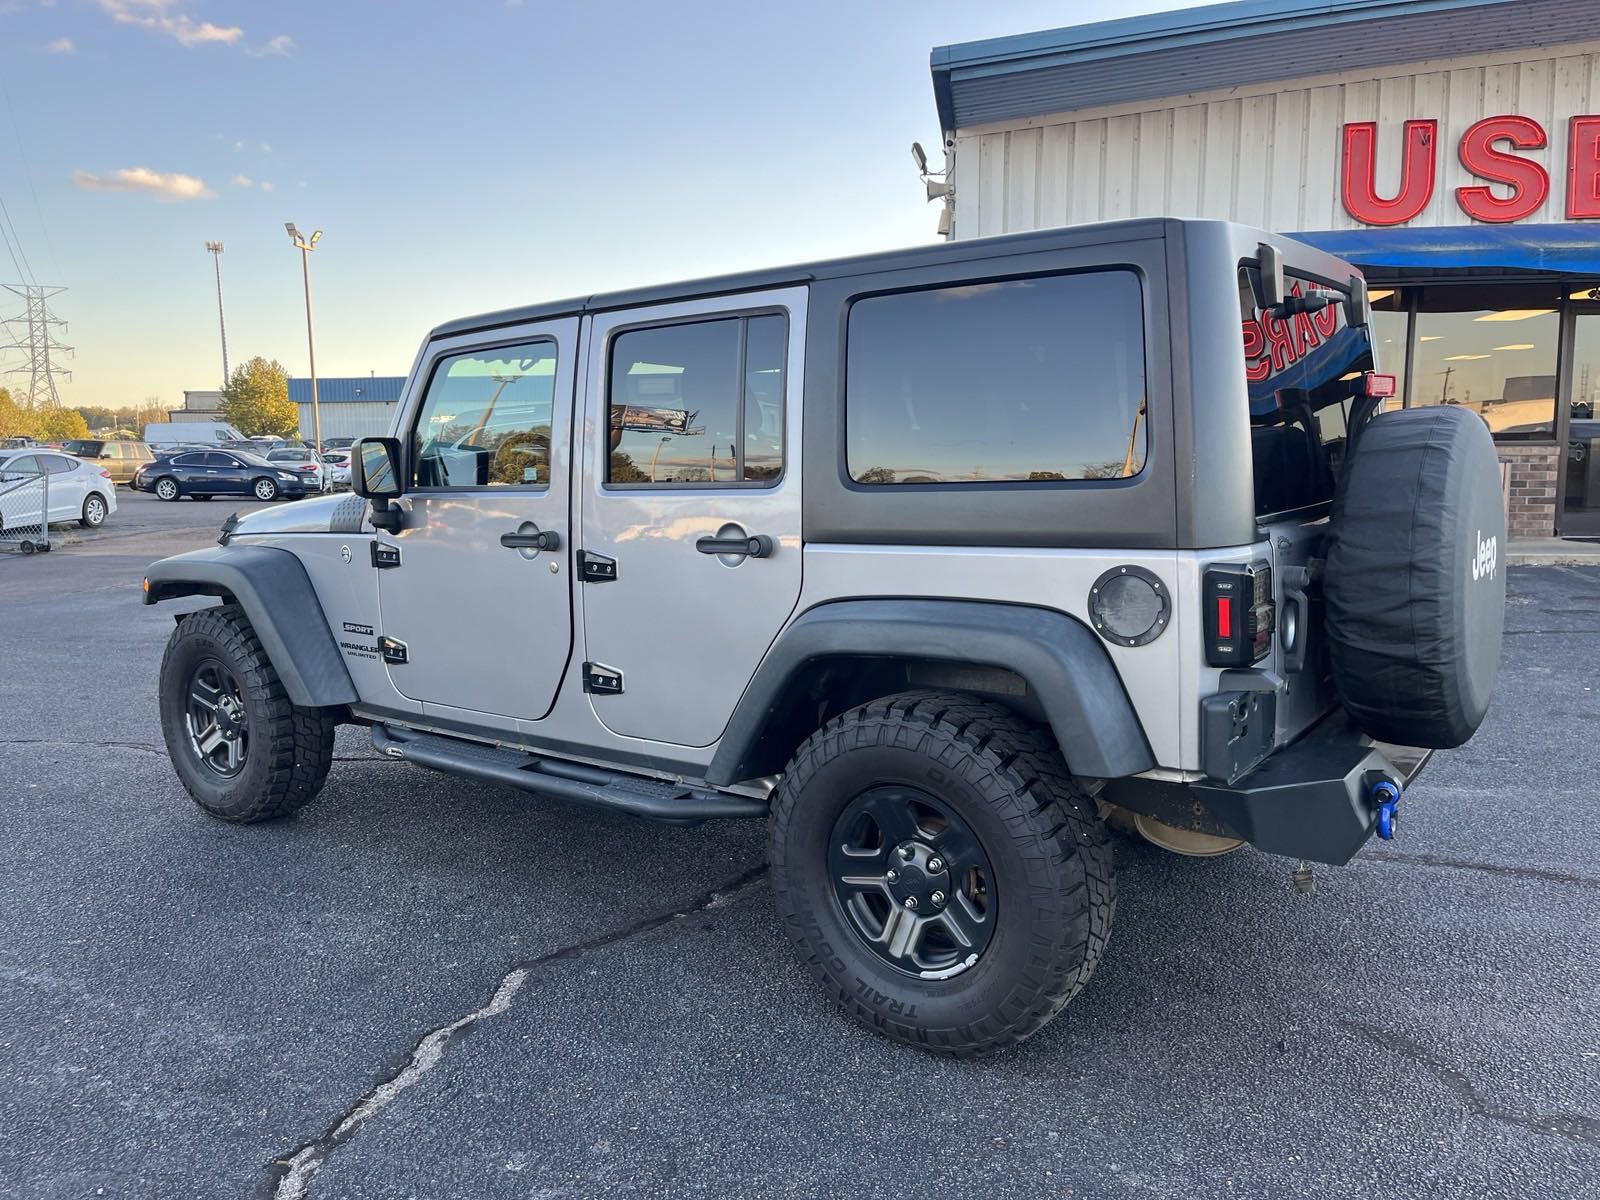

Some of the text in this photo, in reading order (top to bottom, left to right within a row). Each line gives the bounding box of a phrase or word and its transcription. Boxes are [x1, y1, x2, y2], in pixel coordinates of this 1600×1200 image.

[1472, 529, 1497, 581] Jeep
[343, 623, 373, 635] SPORT
[340, 641, 379, 654] WRANGLER
[347, 650, 377, 660] UNLIMITED
[856, 977, 918, 1018] TRAIL
